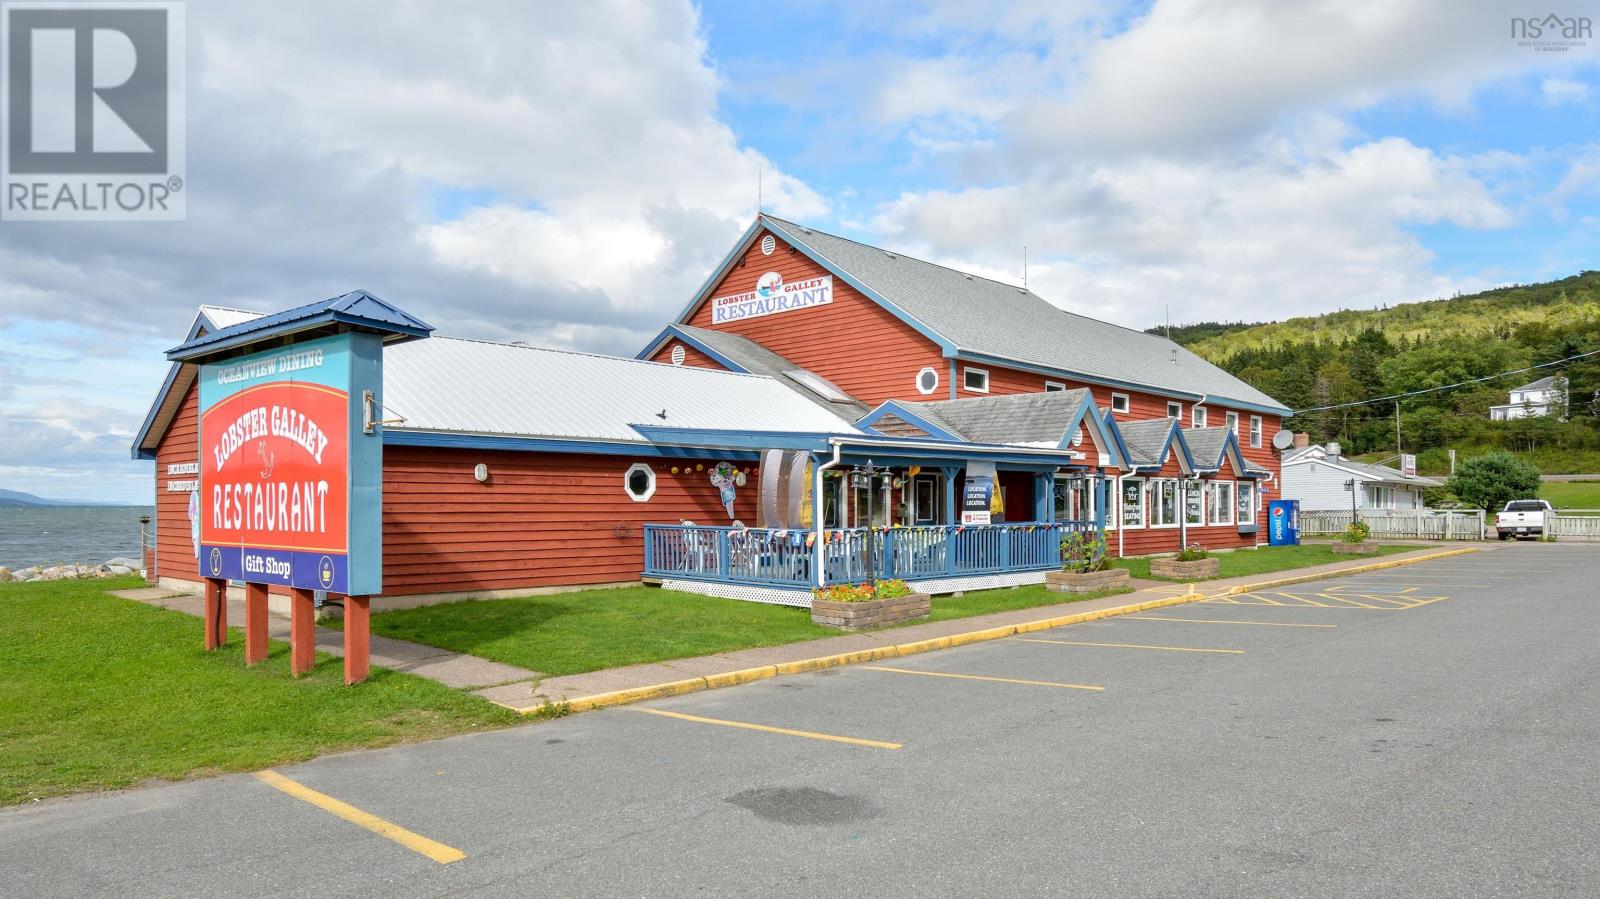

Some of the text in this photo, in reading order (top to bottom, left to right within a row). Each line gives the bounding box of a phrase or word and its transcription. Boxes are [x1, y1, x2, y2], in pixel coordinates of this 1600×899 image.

[716, 287, 829, 321] RESTAURANT
[718, 278, 824, 306] LOBSTER GALLEY
[217, 349, 324, 385] OCEANVIEW DINING
[213, 405, 329, 472] LOBSTER GALLEY
[213, 480, 329, 533] RESTAURANT
[1275, 517, 1284, 540] pepsi
[245, 554, 291, 580] Gift Shop
